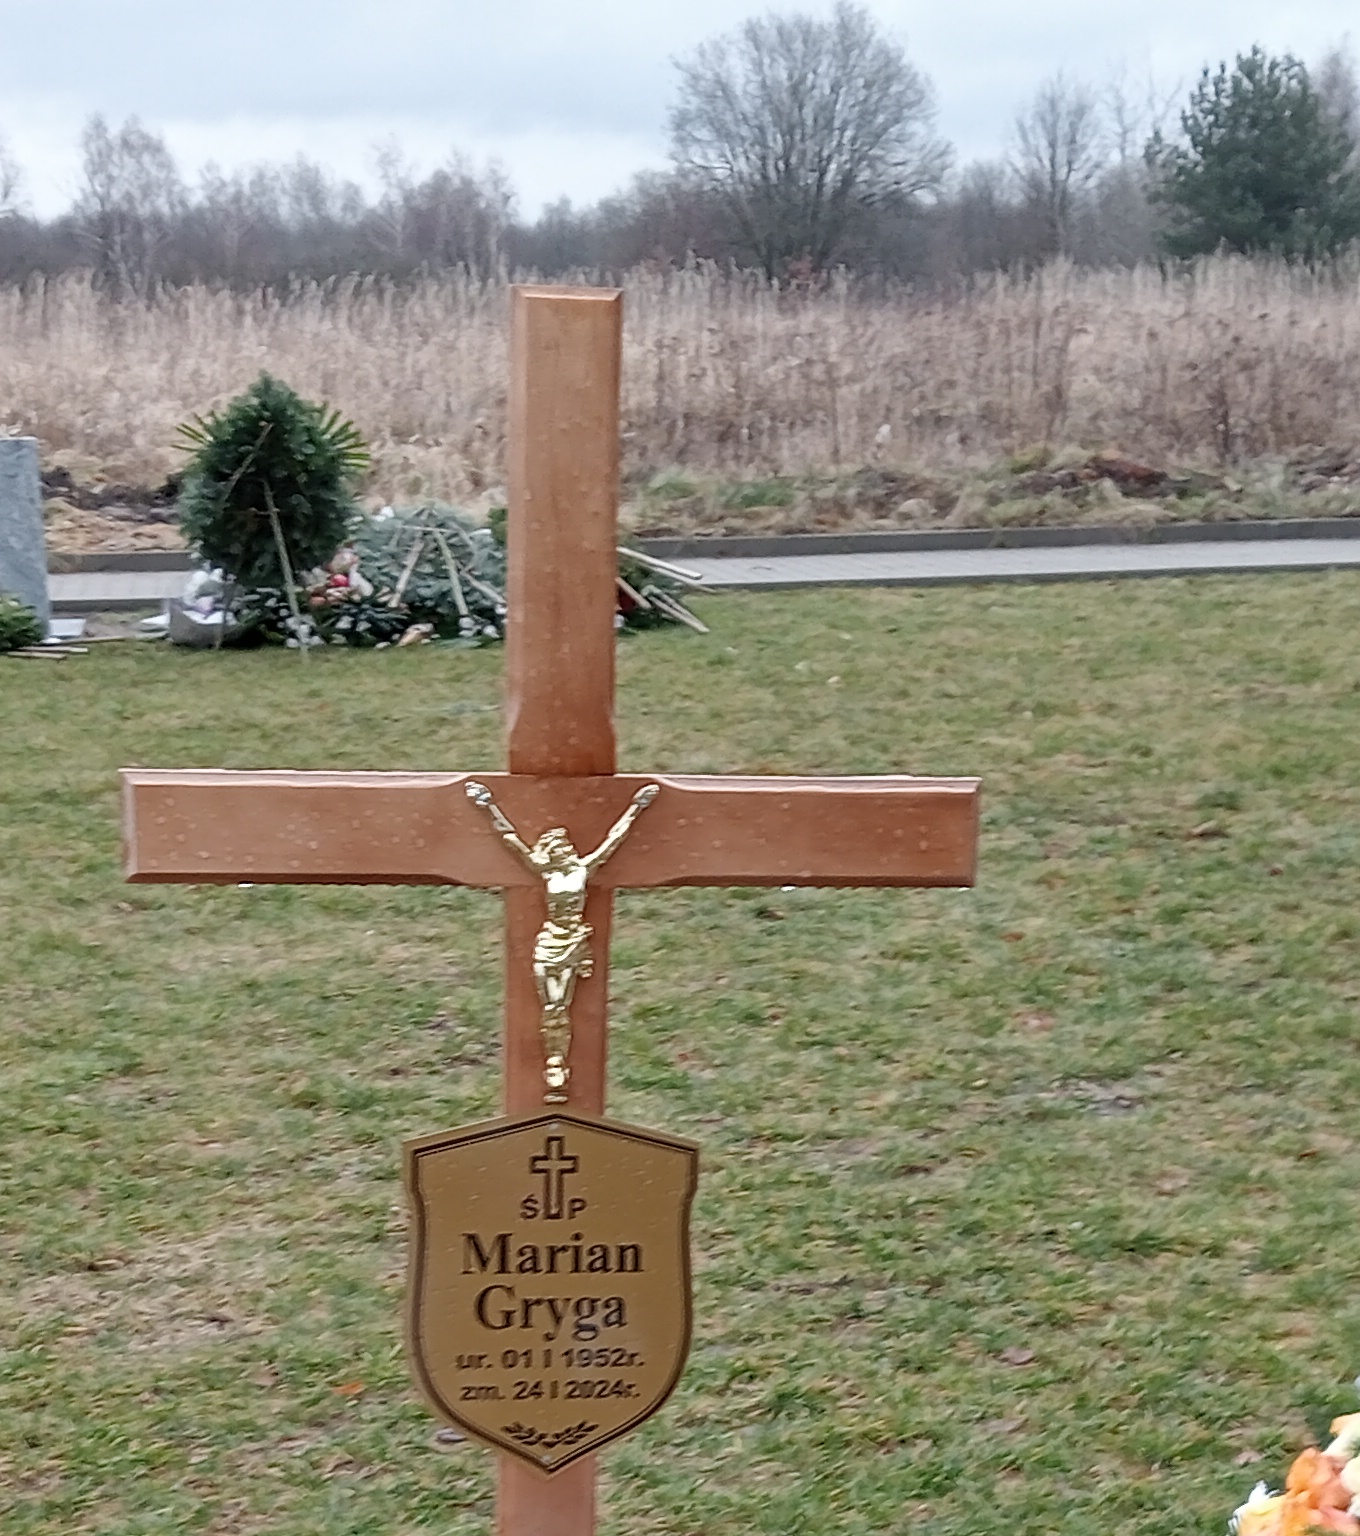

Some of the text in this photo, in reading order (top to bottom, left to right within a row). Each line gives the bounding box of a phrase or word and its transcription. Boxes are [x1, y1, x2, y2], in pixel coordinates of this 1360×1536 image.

[460, 1230, 644, 1275] Marian
[475, 1284, 627, 1342] Gryga
[455, 1353, 492, 1370] ur.
[501, 1349, 533, 1369] 01
[561, 1347, 645, 1369] 1952r.
[460, 1385, 504, 1400] zm.
[513, 1380, 544, 1400] 24
[564, 1379, 641, 1400] 2024r.
